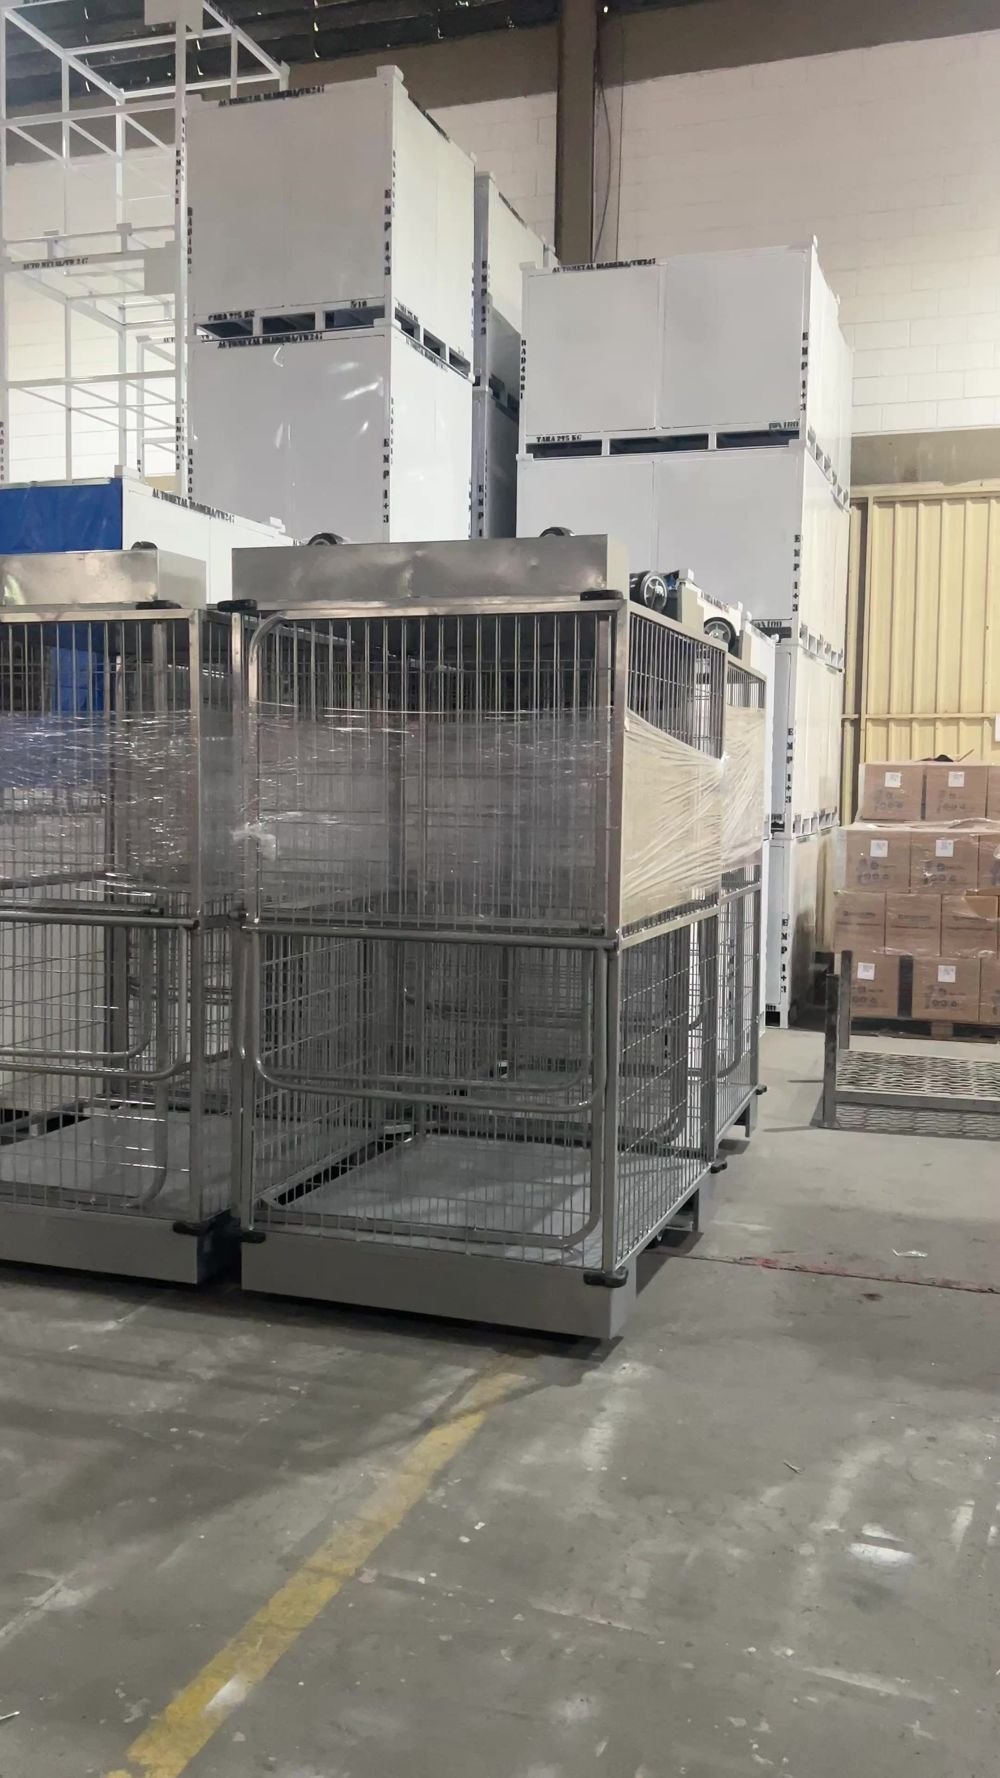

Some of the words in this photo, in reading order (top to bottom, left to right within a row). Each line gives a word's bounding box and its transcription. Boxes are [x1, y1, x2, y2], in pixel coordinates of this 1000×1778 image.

[552, 262, 595, 273] AUTOMETAL
[801, 331, 809, 371] EMP
[536, 435, 556, 444] TARA
[793, 534, 801, 572] EMP
[786, 727, 794, 764] EMP
[780, 918, 789, 955] EMP
